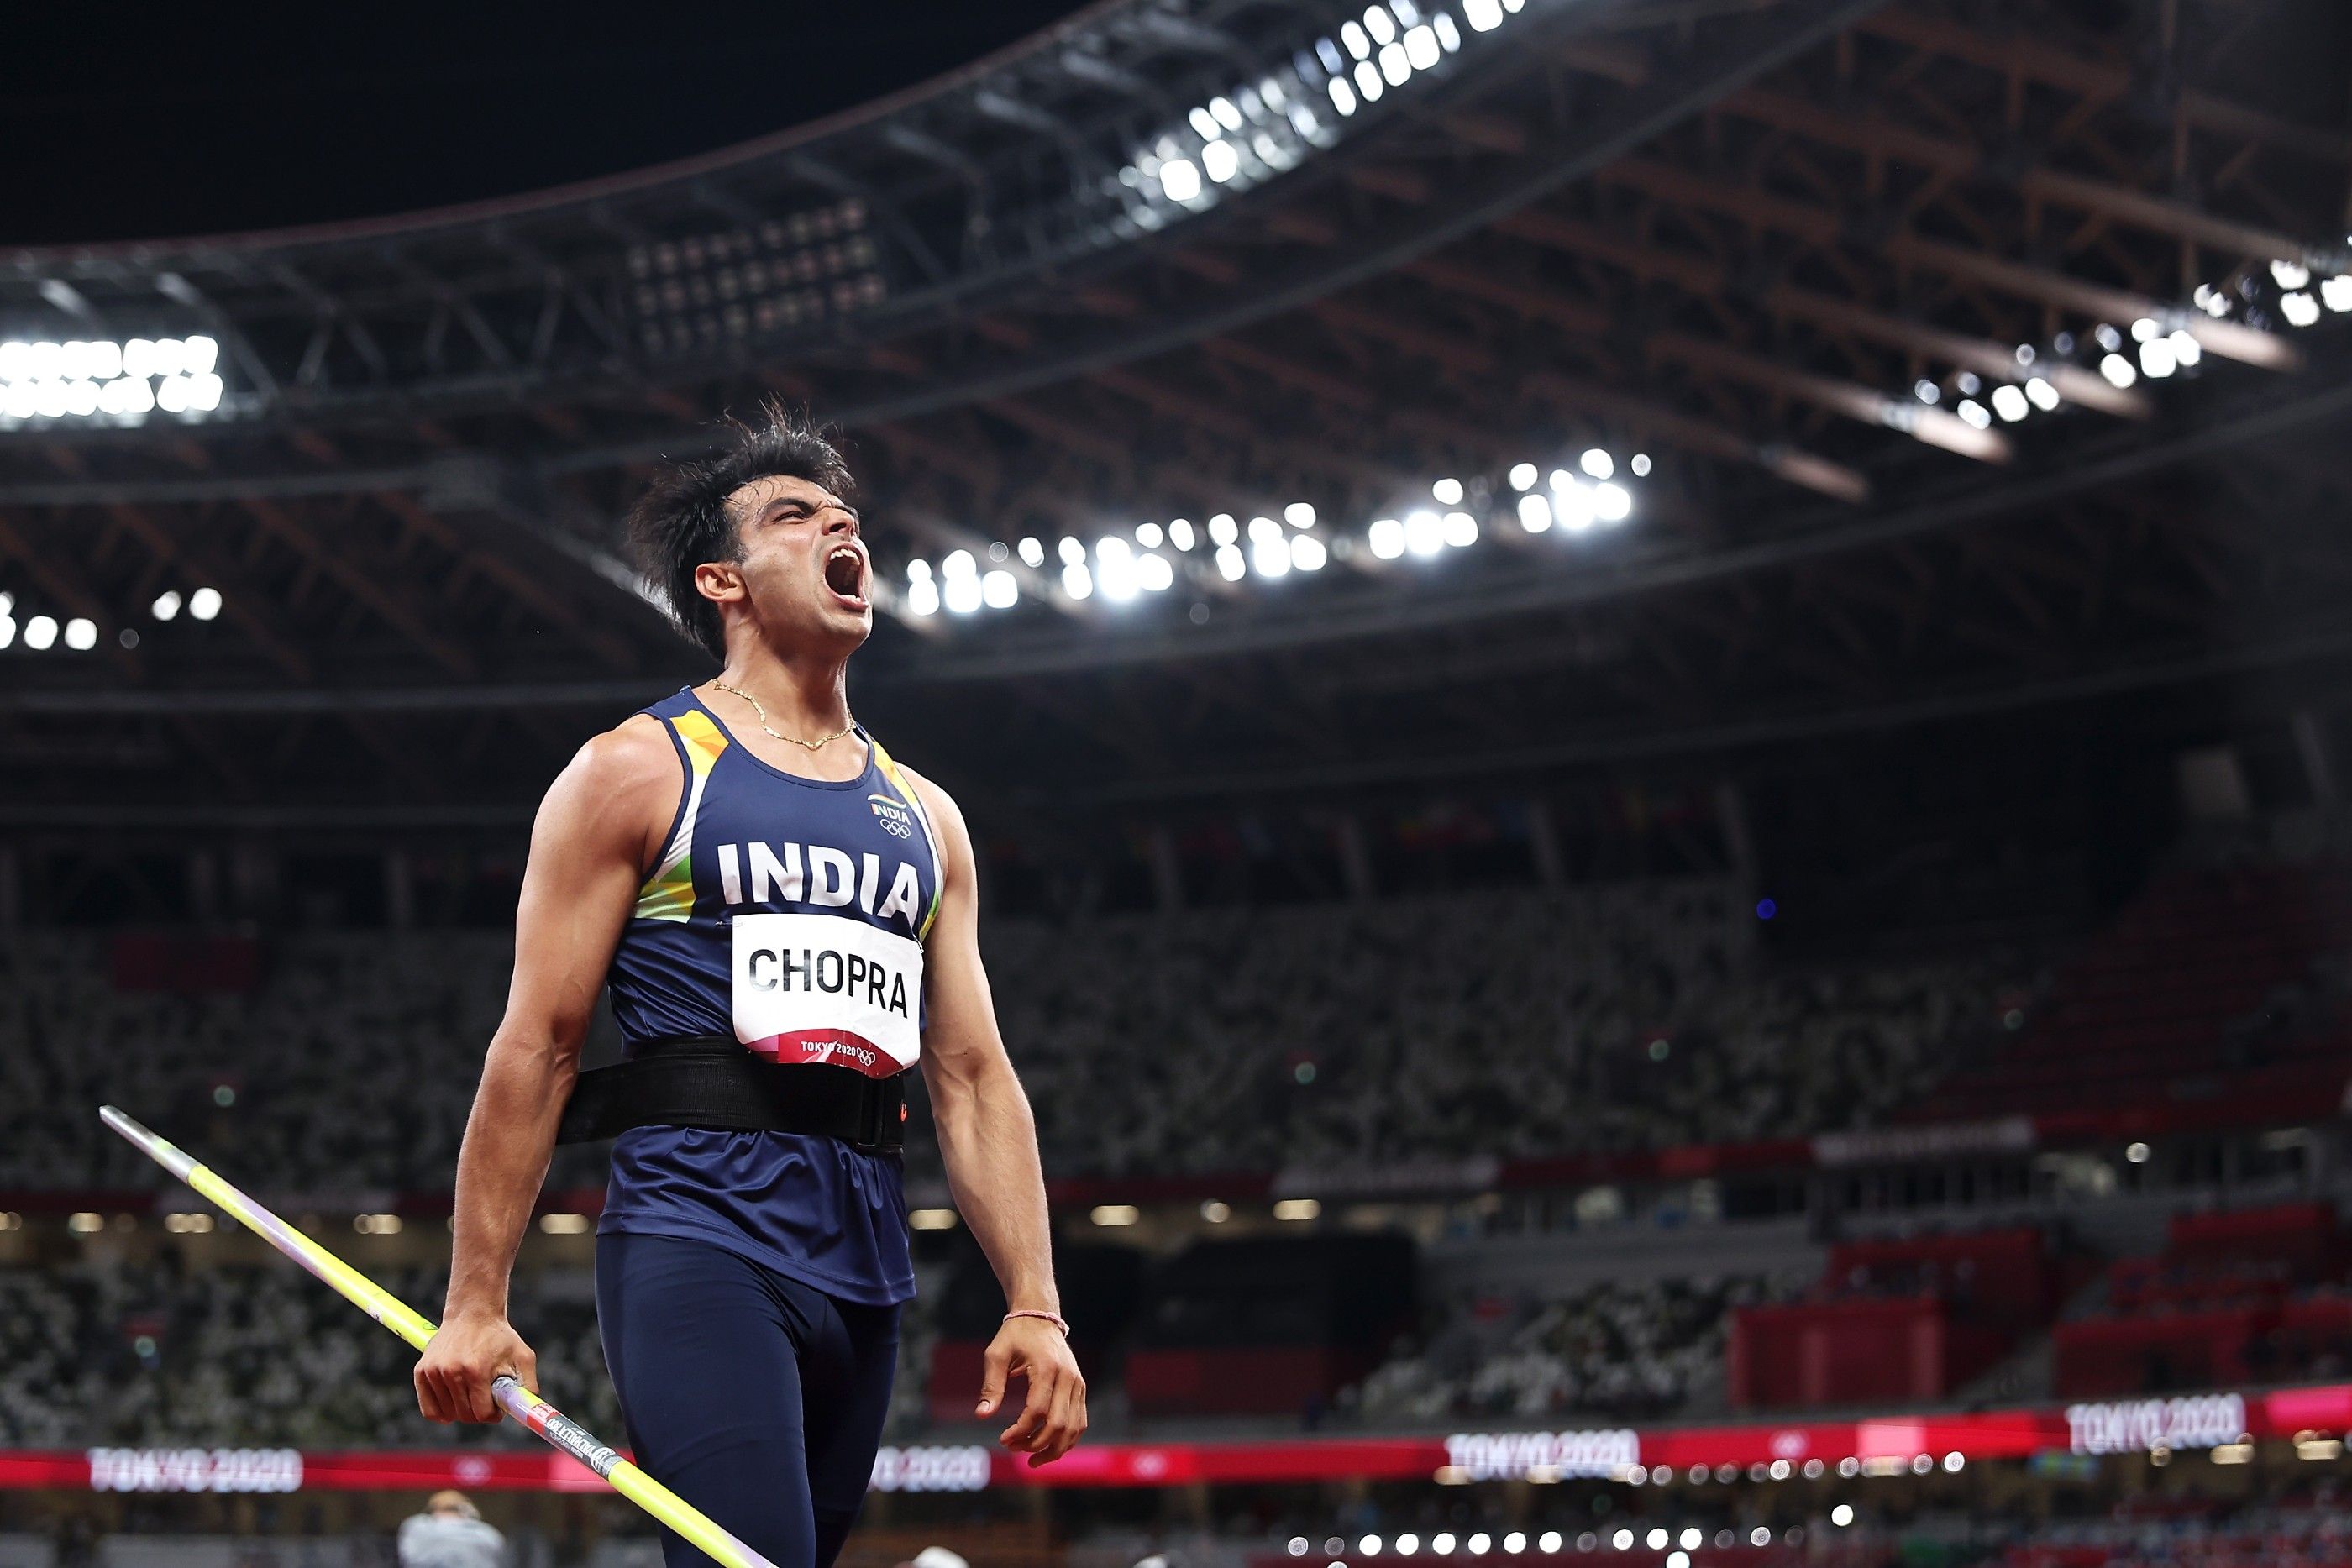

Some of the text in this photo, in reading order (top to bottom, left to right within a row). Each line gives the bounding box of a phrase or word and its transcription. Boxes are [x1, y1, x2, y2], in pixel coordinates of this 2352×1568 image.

[870, 803, 911, 826] INDIA
[717, 842, 920, 931] INDIA
[748, 948, 908, 1019] CHOPRA
[801, 1041, 857, 1057] TOKYO 2020
